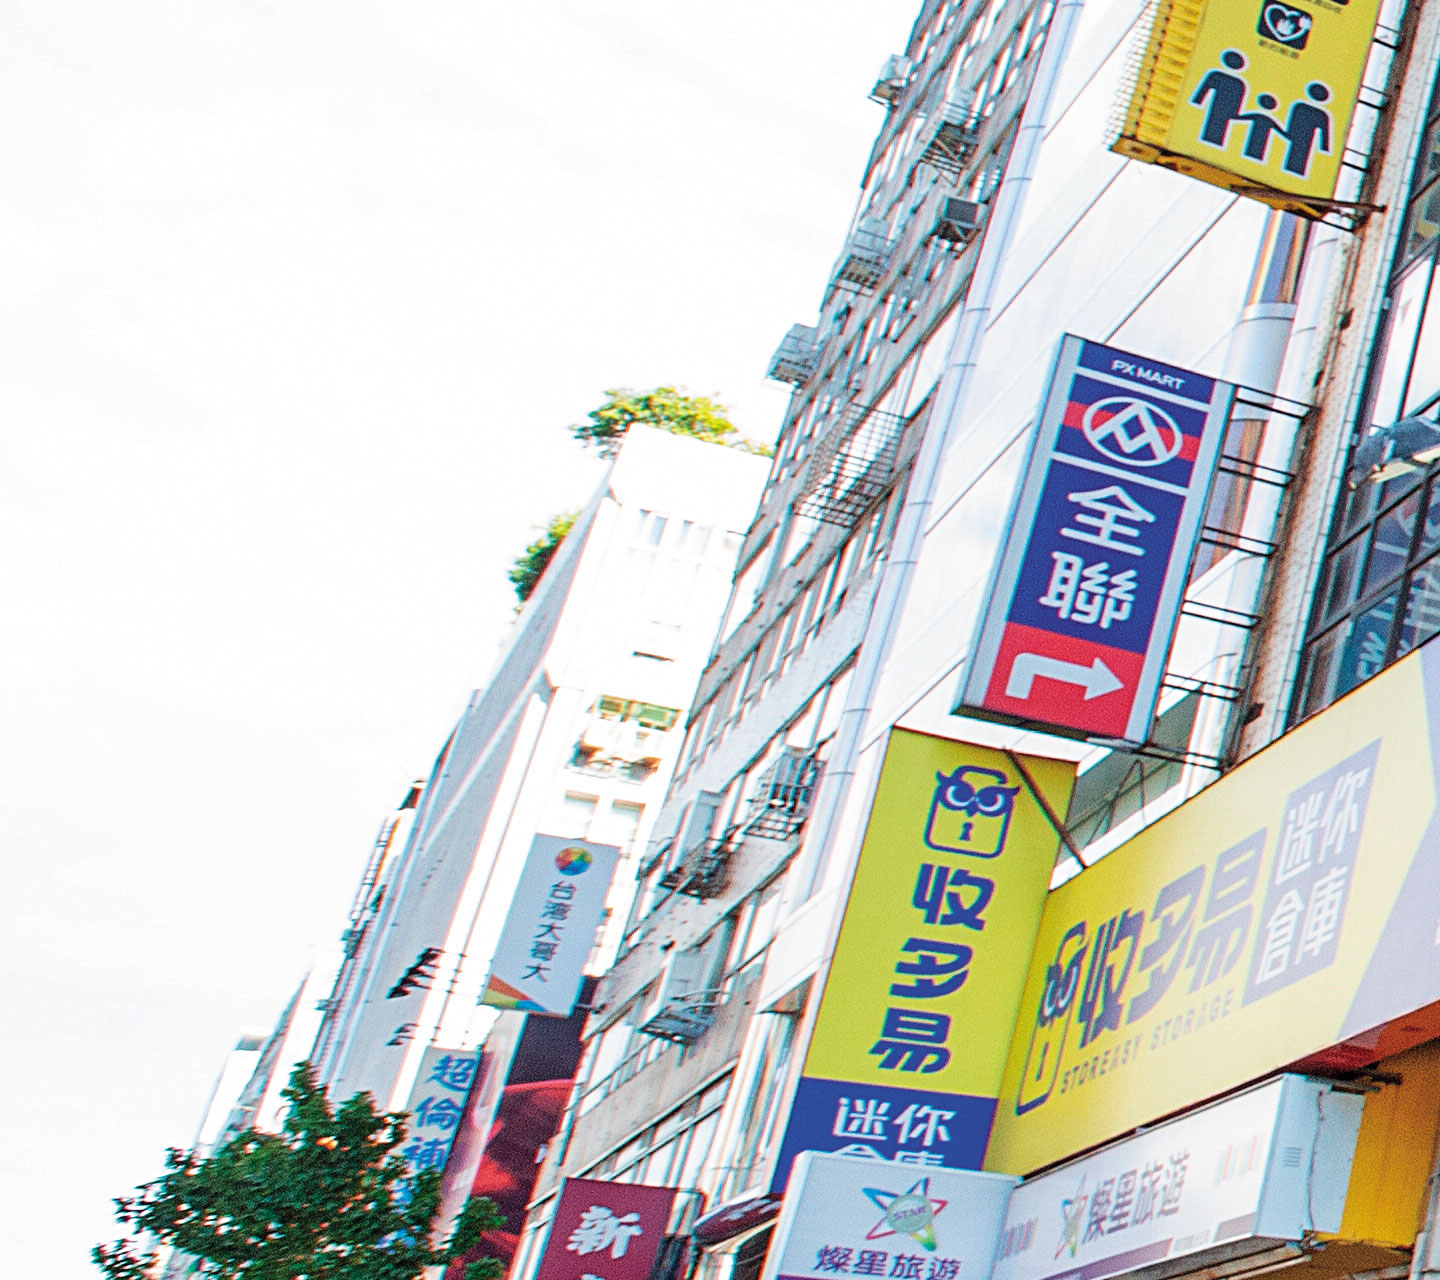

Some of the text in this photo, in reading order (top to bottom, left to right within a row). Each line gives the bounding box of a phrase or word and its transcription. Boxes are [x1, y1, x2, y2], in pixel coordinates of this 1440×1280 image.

[1111, 359, 1185, 390] PX MART
[1039, 486, 1157, 629] 全聯
[1275, 765, 1367, 885] 迷你
[520, 880, 577, 982] 台灣大哥大
[869, 863, 995, 1074] 收多易
[1078, 827, 1269, 1049] 收多易
[1257, 867, 1351, 986] 倉庫
[1061, 989, 1234, 1093] STOREASY STORAGE
[833, 1096, 957, 1147] 迷你
[1082, 1147, 1191, 1244] 燦星旅遊
